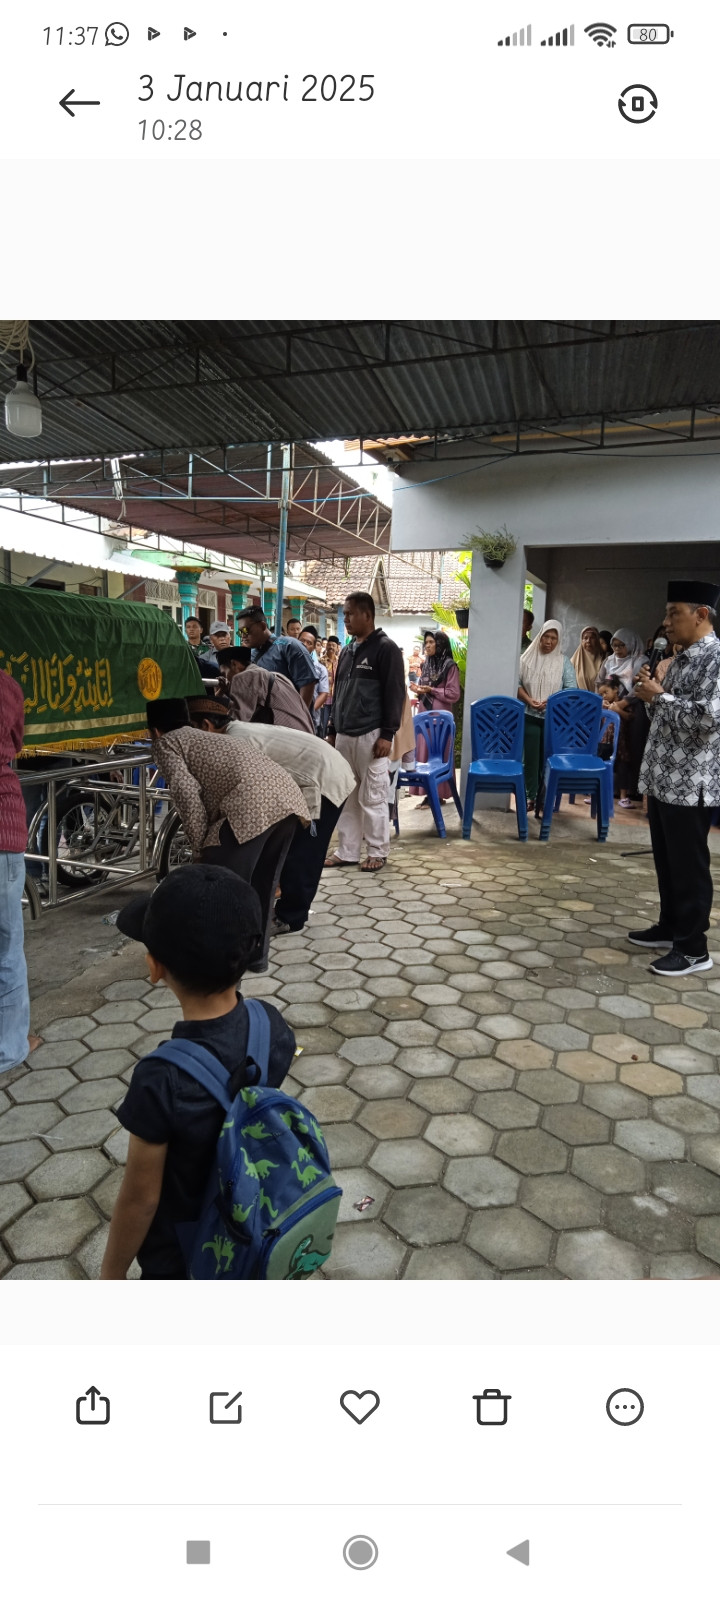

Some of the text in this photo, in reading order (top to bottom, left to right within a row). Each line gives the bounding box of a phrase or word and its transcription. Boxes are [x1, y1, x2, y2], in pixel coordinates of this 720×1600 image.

[43, 26, 99, 46] 11:37
[640, 28, 657, 42] 80
[138, 74, 375, 102] 3 Januari 2025
[138, 119, 203, 141] 10:28
